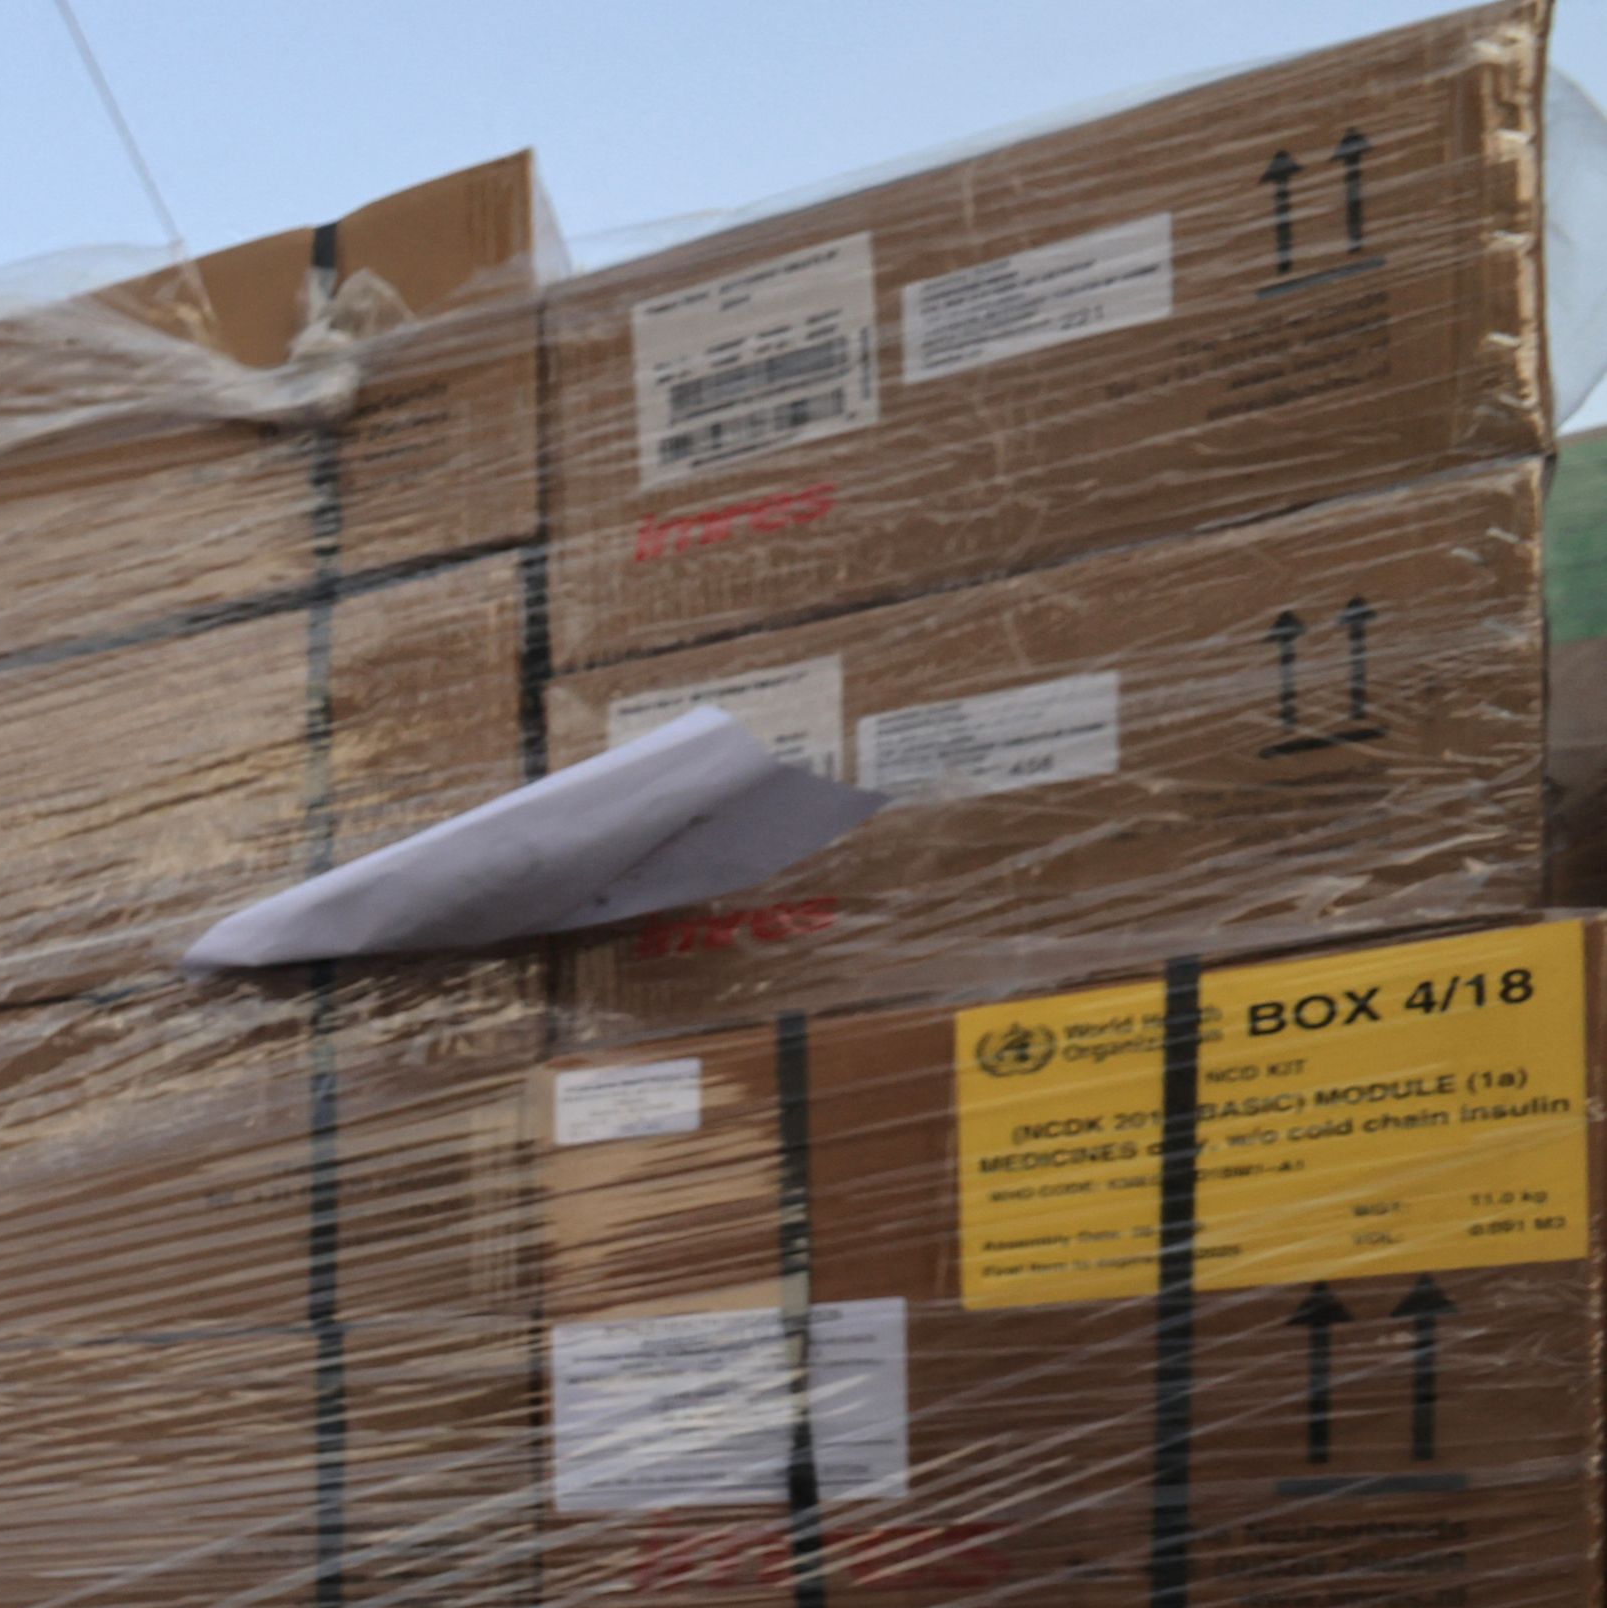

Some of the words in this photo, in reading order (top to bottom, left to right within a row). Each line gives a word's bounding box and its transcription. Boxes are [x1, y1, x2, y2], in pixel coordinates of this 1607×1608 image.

[635, 482, 837, 561] imres
[1247, 986, 1382, 1037] BOX
[1404, 967, 1533, 1015] 4/18
[1204, 1065, 1260, 1084] NCD
[1265, 1059, 1308, 1079] KIT
[1314, 1074, 1457, 1109] MODULE
[1466, 1067, 1528, 1095] (1a)
[979, 1140, 1138, 1174] MEDICINES
[1286, 1117, 1354, 1142] cold
[1362, 1107, 1450, 1136] chain
[1459, 1095, 1571, 1123] insulin
